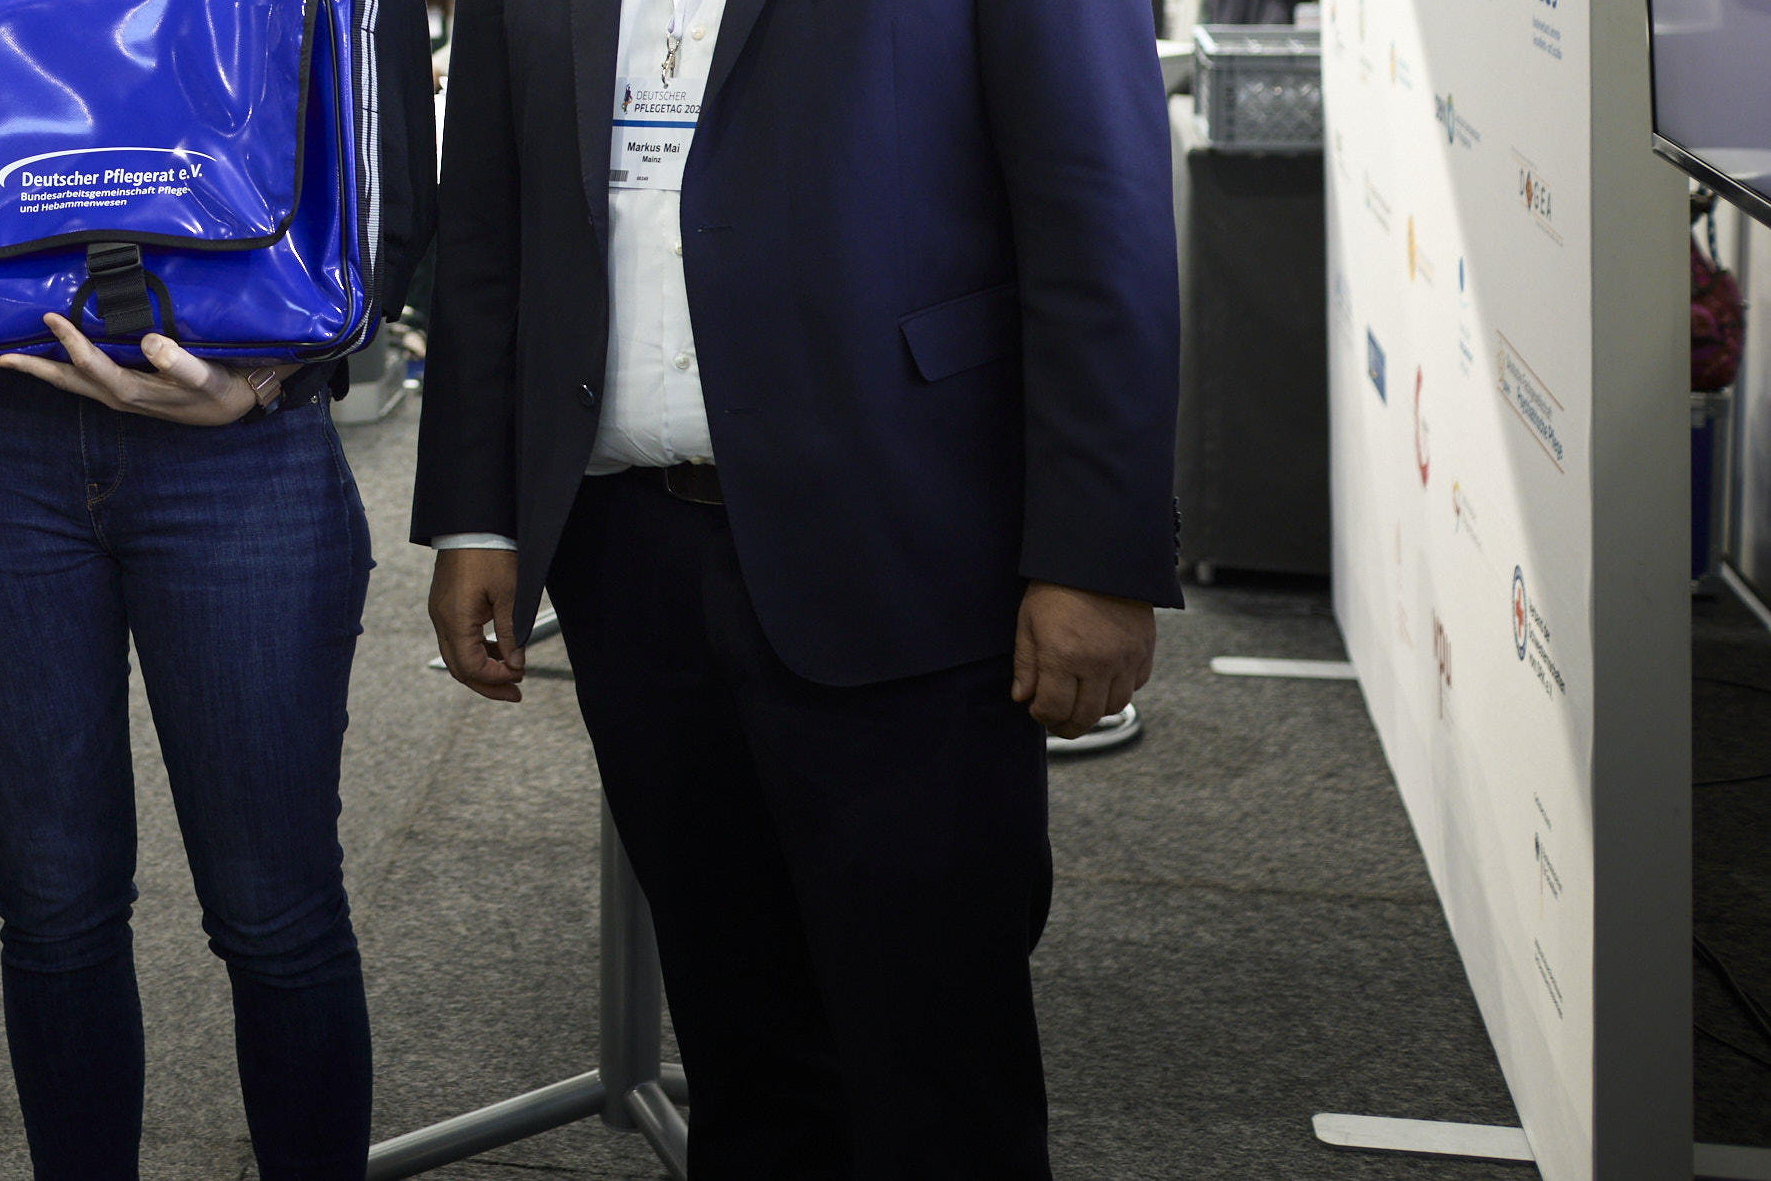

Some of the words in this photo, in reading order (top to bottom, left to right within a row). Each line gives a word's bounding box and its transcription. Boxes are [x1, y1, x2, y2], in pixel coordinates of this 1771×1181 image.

[636, 90, 687, 101] DEUTSCHER
[634, 103, 682, 114] PFLEGETAG
[684, 104, 701, 114] 202
[627, 142, 661, 152] Markus
[663, 143, 681, 153] Mai
[642, 155, 661, 163] Mainz
[22, 171, 99, 187] Deutscher
[104, 168, 174, 186] Pflegerat
[179, 164, 203, 180] e.V.
[20, 186, 155, 201] Bundesarbeitsgemeinschaft
[158, 186, 190, 197] Pflege-
[19, 204, 39, 213] und
[41, 199, 127, 212] Hebammenwesen
[1431, 607, 1451, 719] vpu
